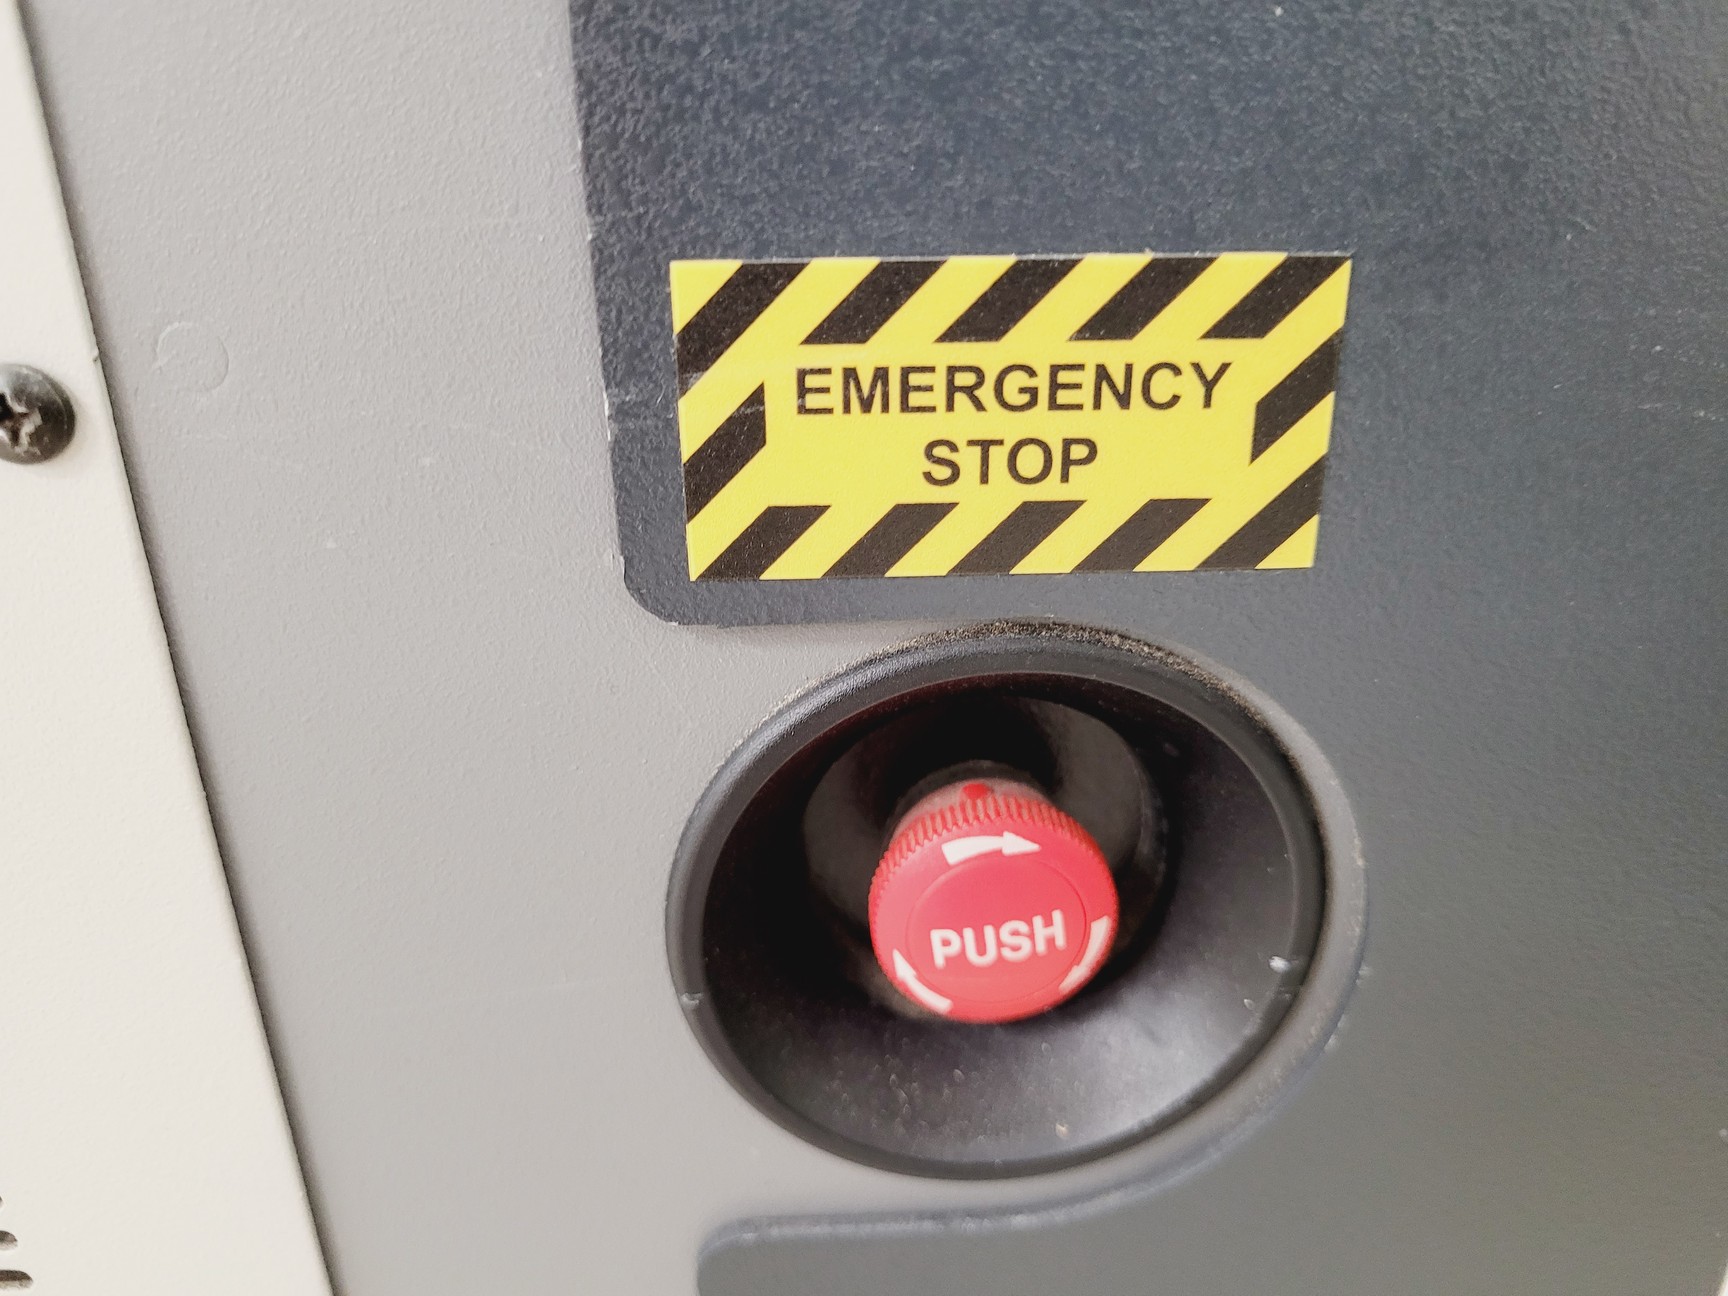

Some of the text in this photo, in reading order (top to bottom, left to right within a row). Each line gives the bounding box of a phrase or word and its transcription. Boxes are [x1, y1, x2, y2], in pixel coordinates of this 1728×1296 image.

[796, 362, 1232, 415] EMERGENCY
[921, 437, 1098, 486] STOP
[930, 909, 1067, 969] PUSH
